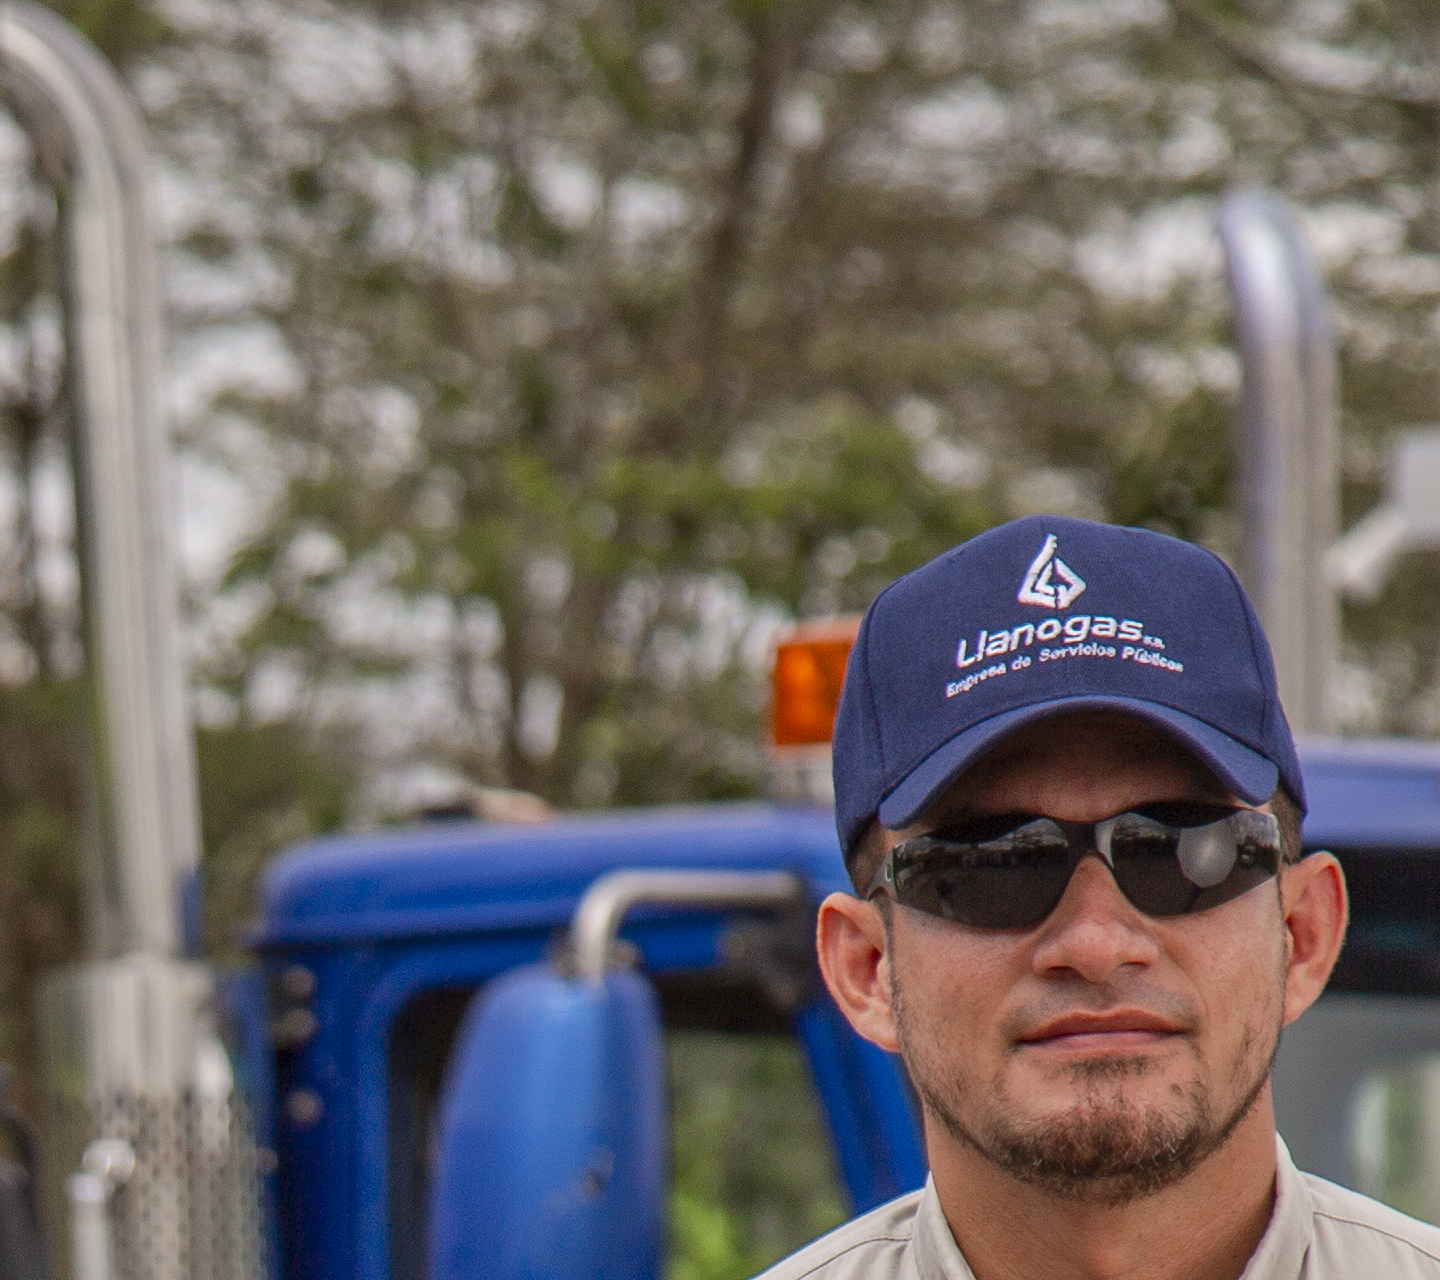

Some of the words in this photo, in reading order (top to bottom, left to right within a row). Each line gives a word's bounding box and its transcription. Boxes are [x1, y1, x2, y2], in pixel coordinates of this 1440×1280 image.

[945, 662, 1007, 698] Empresa
[1010, 655, 1032, 671] de
[1038, 641, 1117, 663] Servicios
[955, 614, 1144, 669] Llanogas
